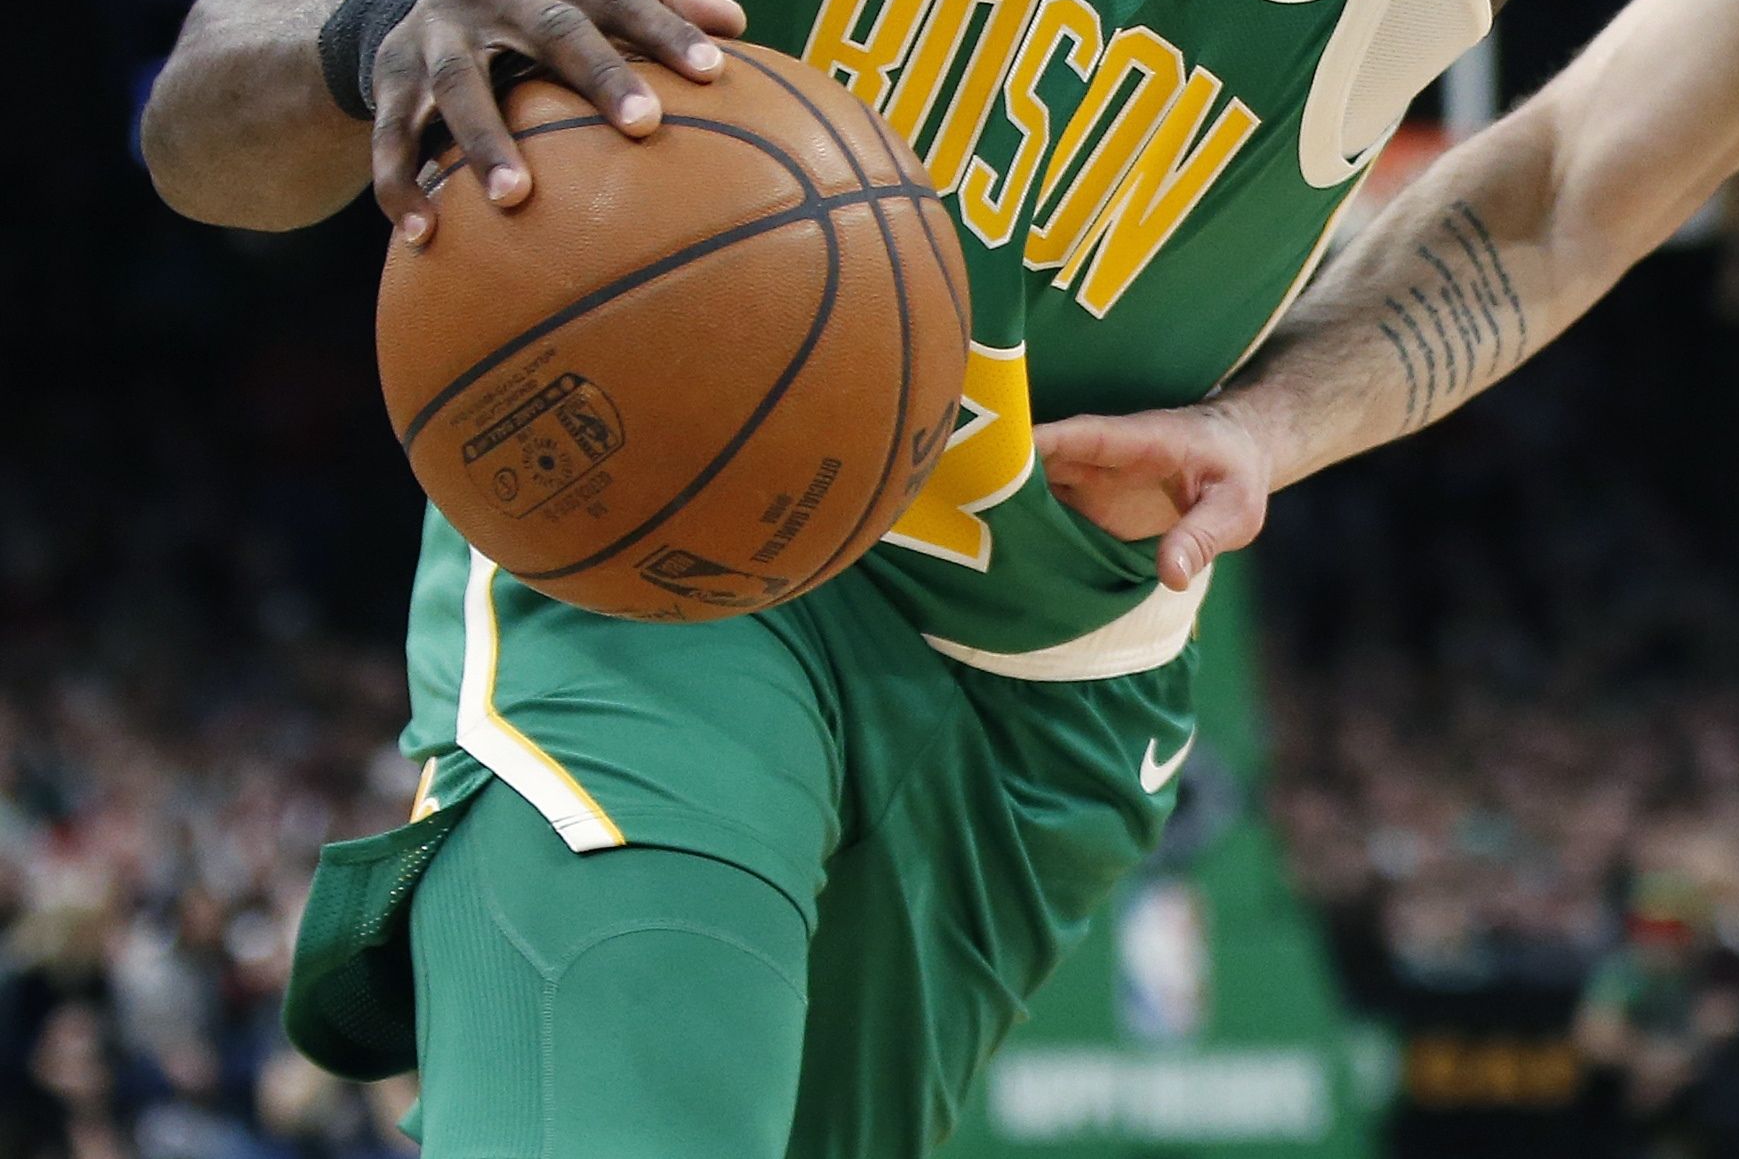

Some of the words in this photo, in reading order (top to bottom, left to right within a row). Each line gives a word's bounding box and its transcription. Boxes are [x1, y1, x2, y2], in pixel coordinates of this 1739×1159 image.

[798, 457, 842, 509] OFFICIAL
[774, 510, 810, 541] GAME
[750, 539, 787, 563] BALL
